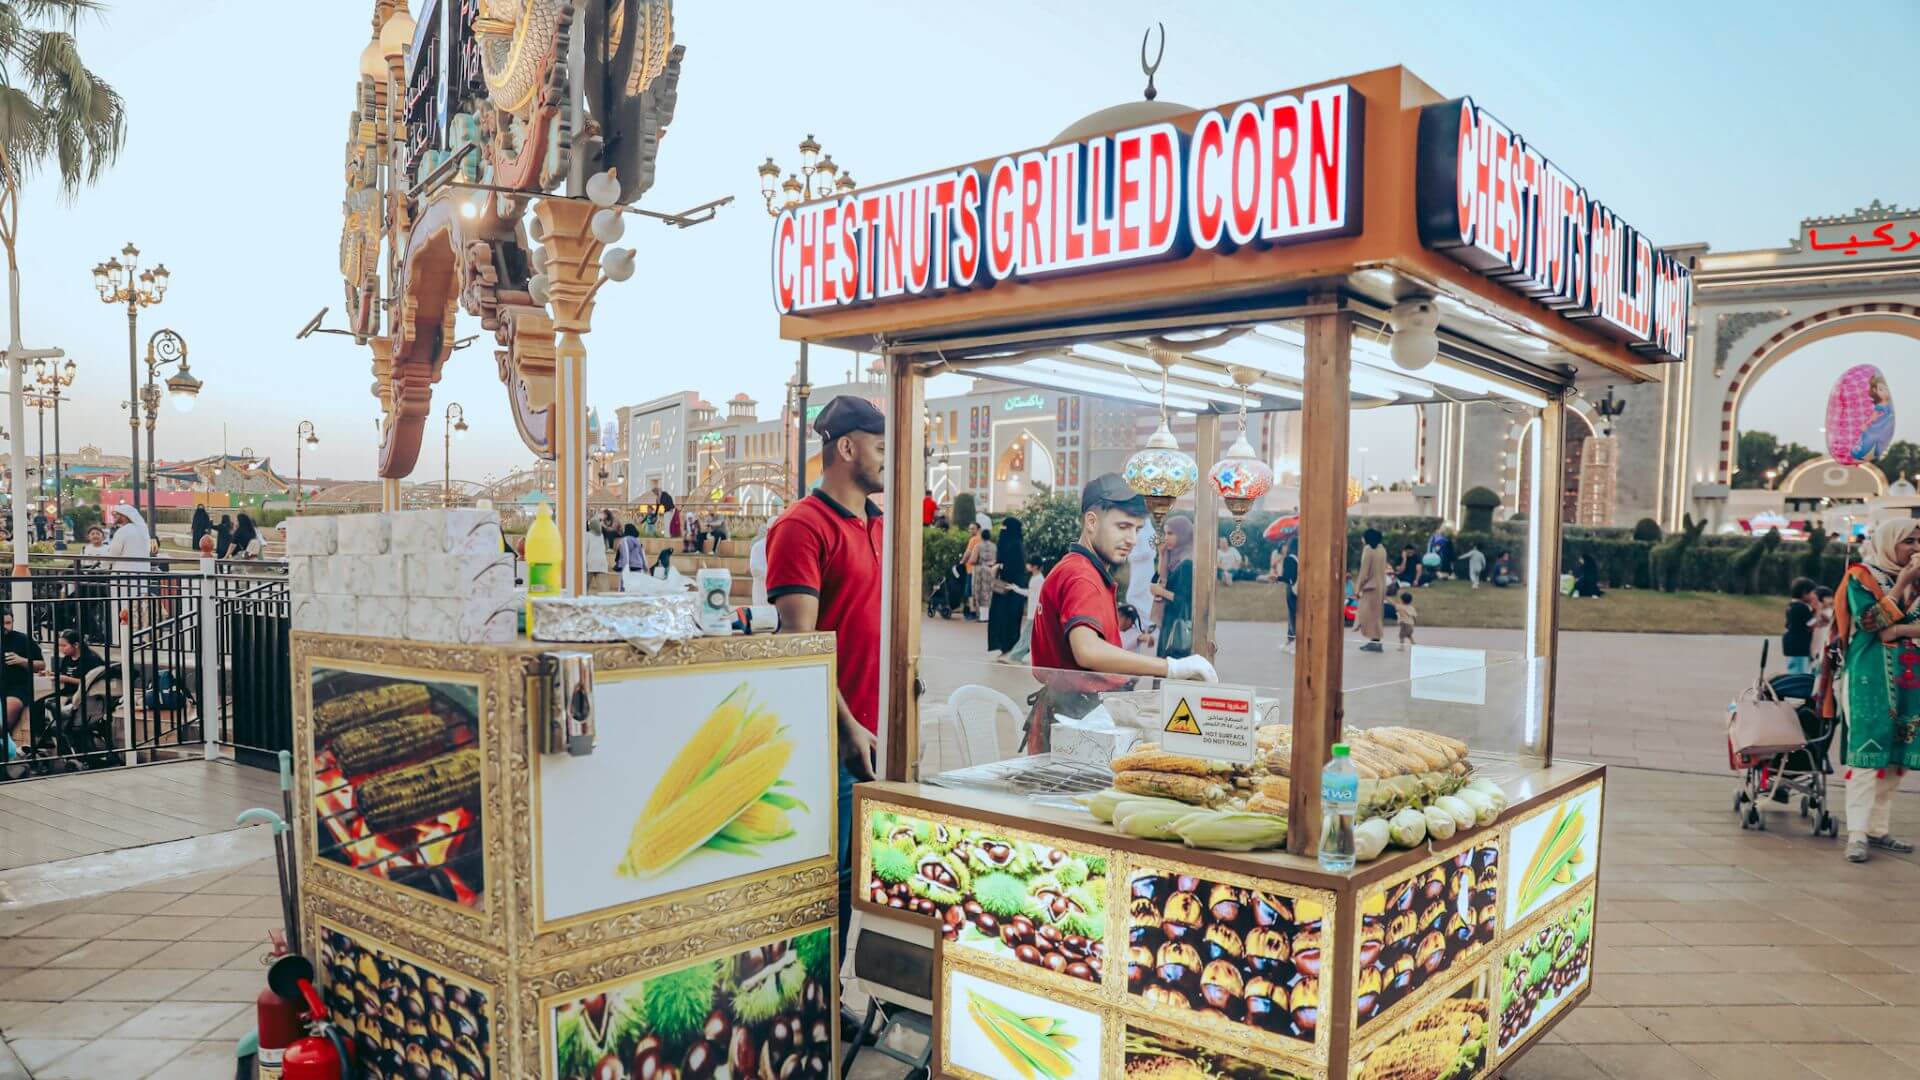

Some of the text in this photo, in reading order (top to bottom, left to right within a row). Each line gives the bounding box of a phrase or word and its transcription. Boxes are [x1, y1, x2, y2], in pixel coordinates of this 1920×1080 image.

[779, 94, 1342, 311] CHESTNUTS GRILLED CORN
[1456, 104, 1588, 306] CHESTNUTS
[1590, 203, 1652, 332] GRILLED
[1808, 222, 1920, 256] ركيا
[1219, 732, 1245, 740] SURFACE
